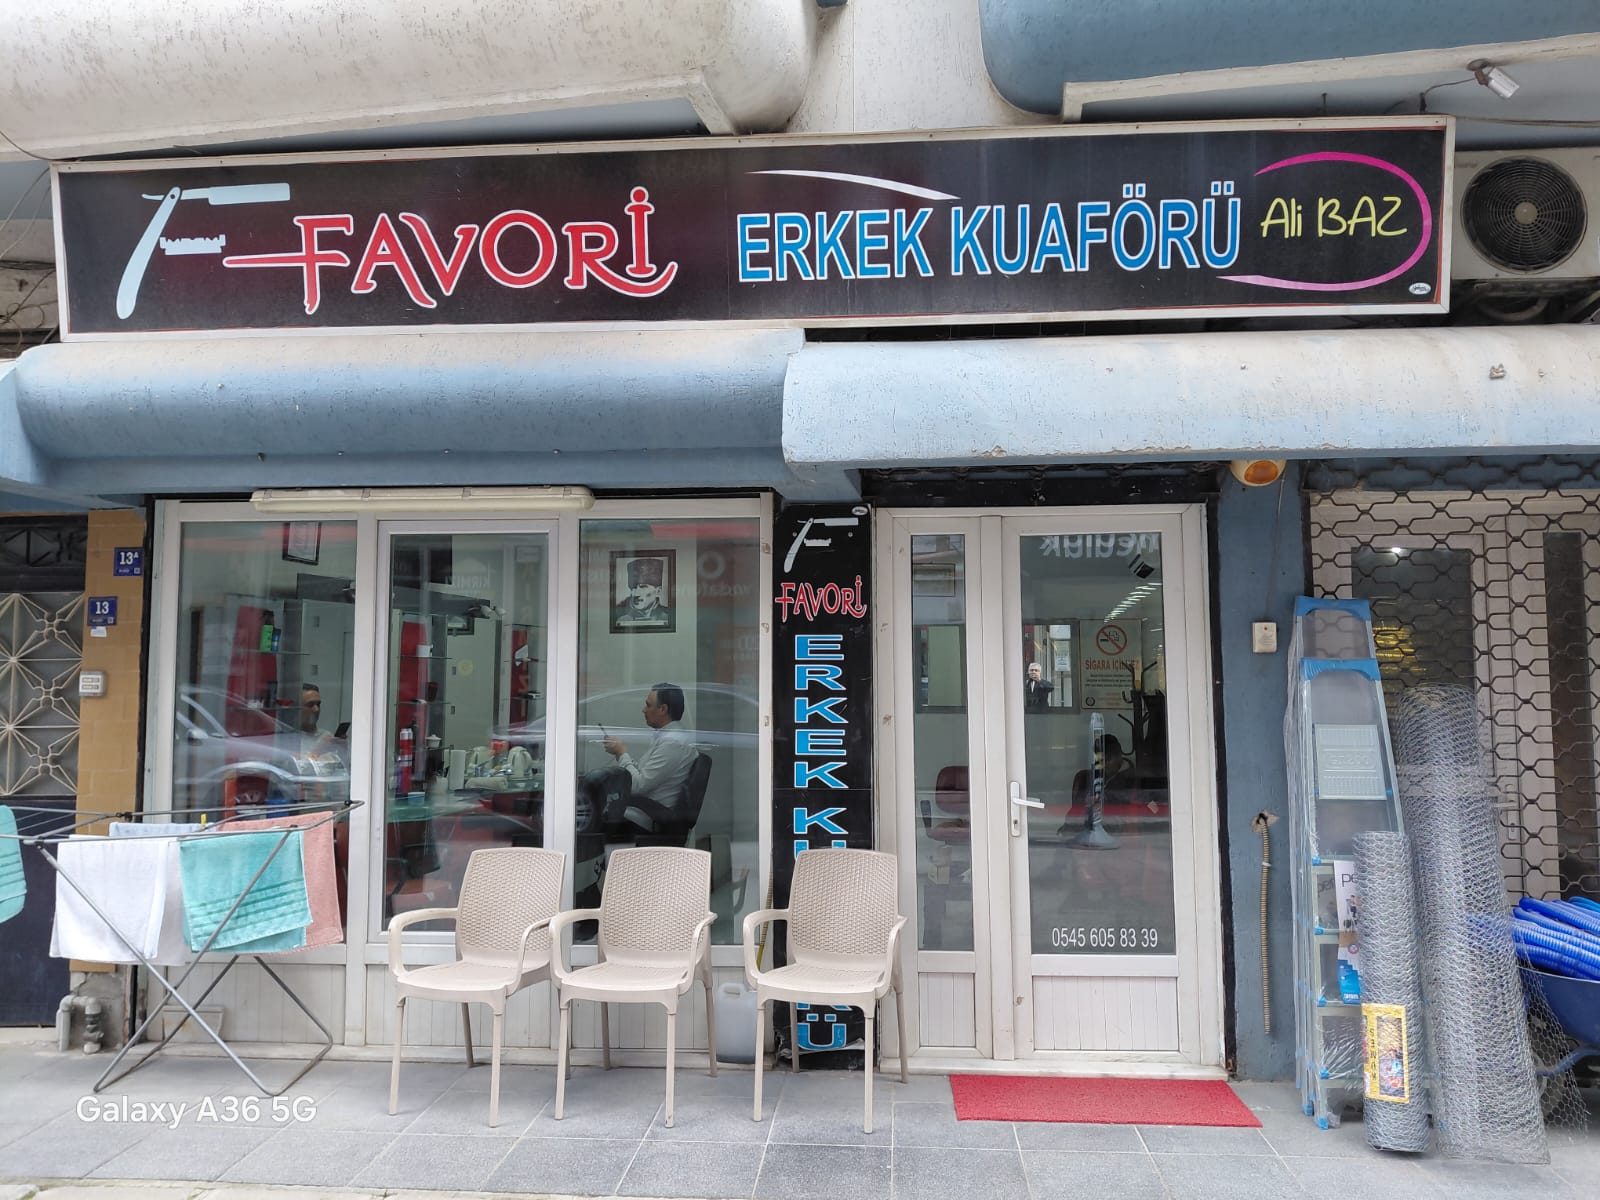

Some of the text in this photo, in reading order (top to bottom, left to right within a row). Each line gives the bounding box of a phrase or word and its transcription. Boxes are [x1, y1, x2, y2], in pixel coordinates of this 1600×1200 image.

[736, 180, 1242, 283] ERKEK KUAFÖRÜ
[1260, 195, 1408, 239] Ali BAZ
[222, 185, 679, 315] FAVORİ
[95, 601, 110, 614] 13
[776, 574, 868, 623] FAVORİ
[1085, 657, 1110, 671] SİGARA
[794, 634, 849, 789] ERKEK
[1052, 927, 1158, 948] 0545 605 83 39
